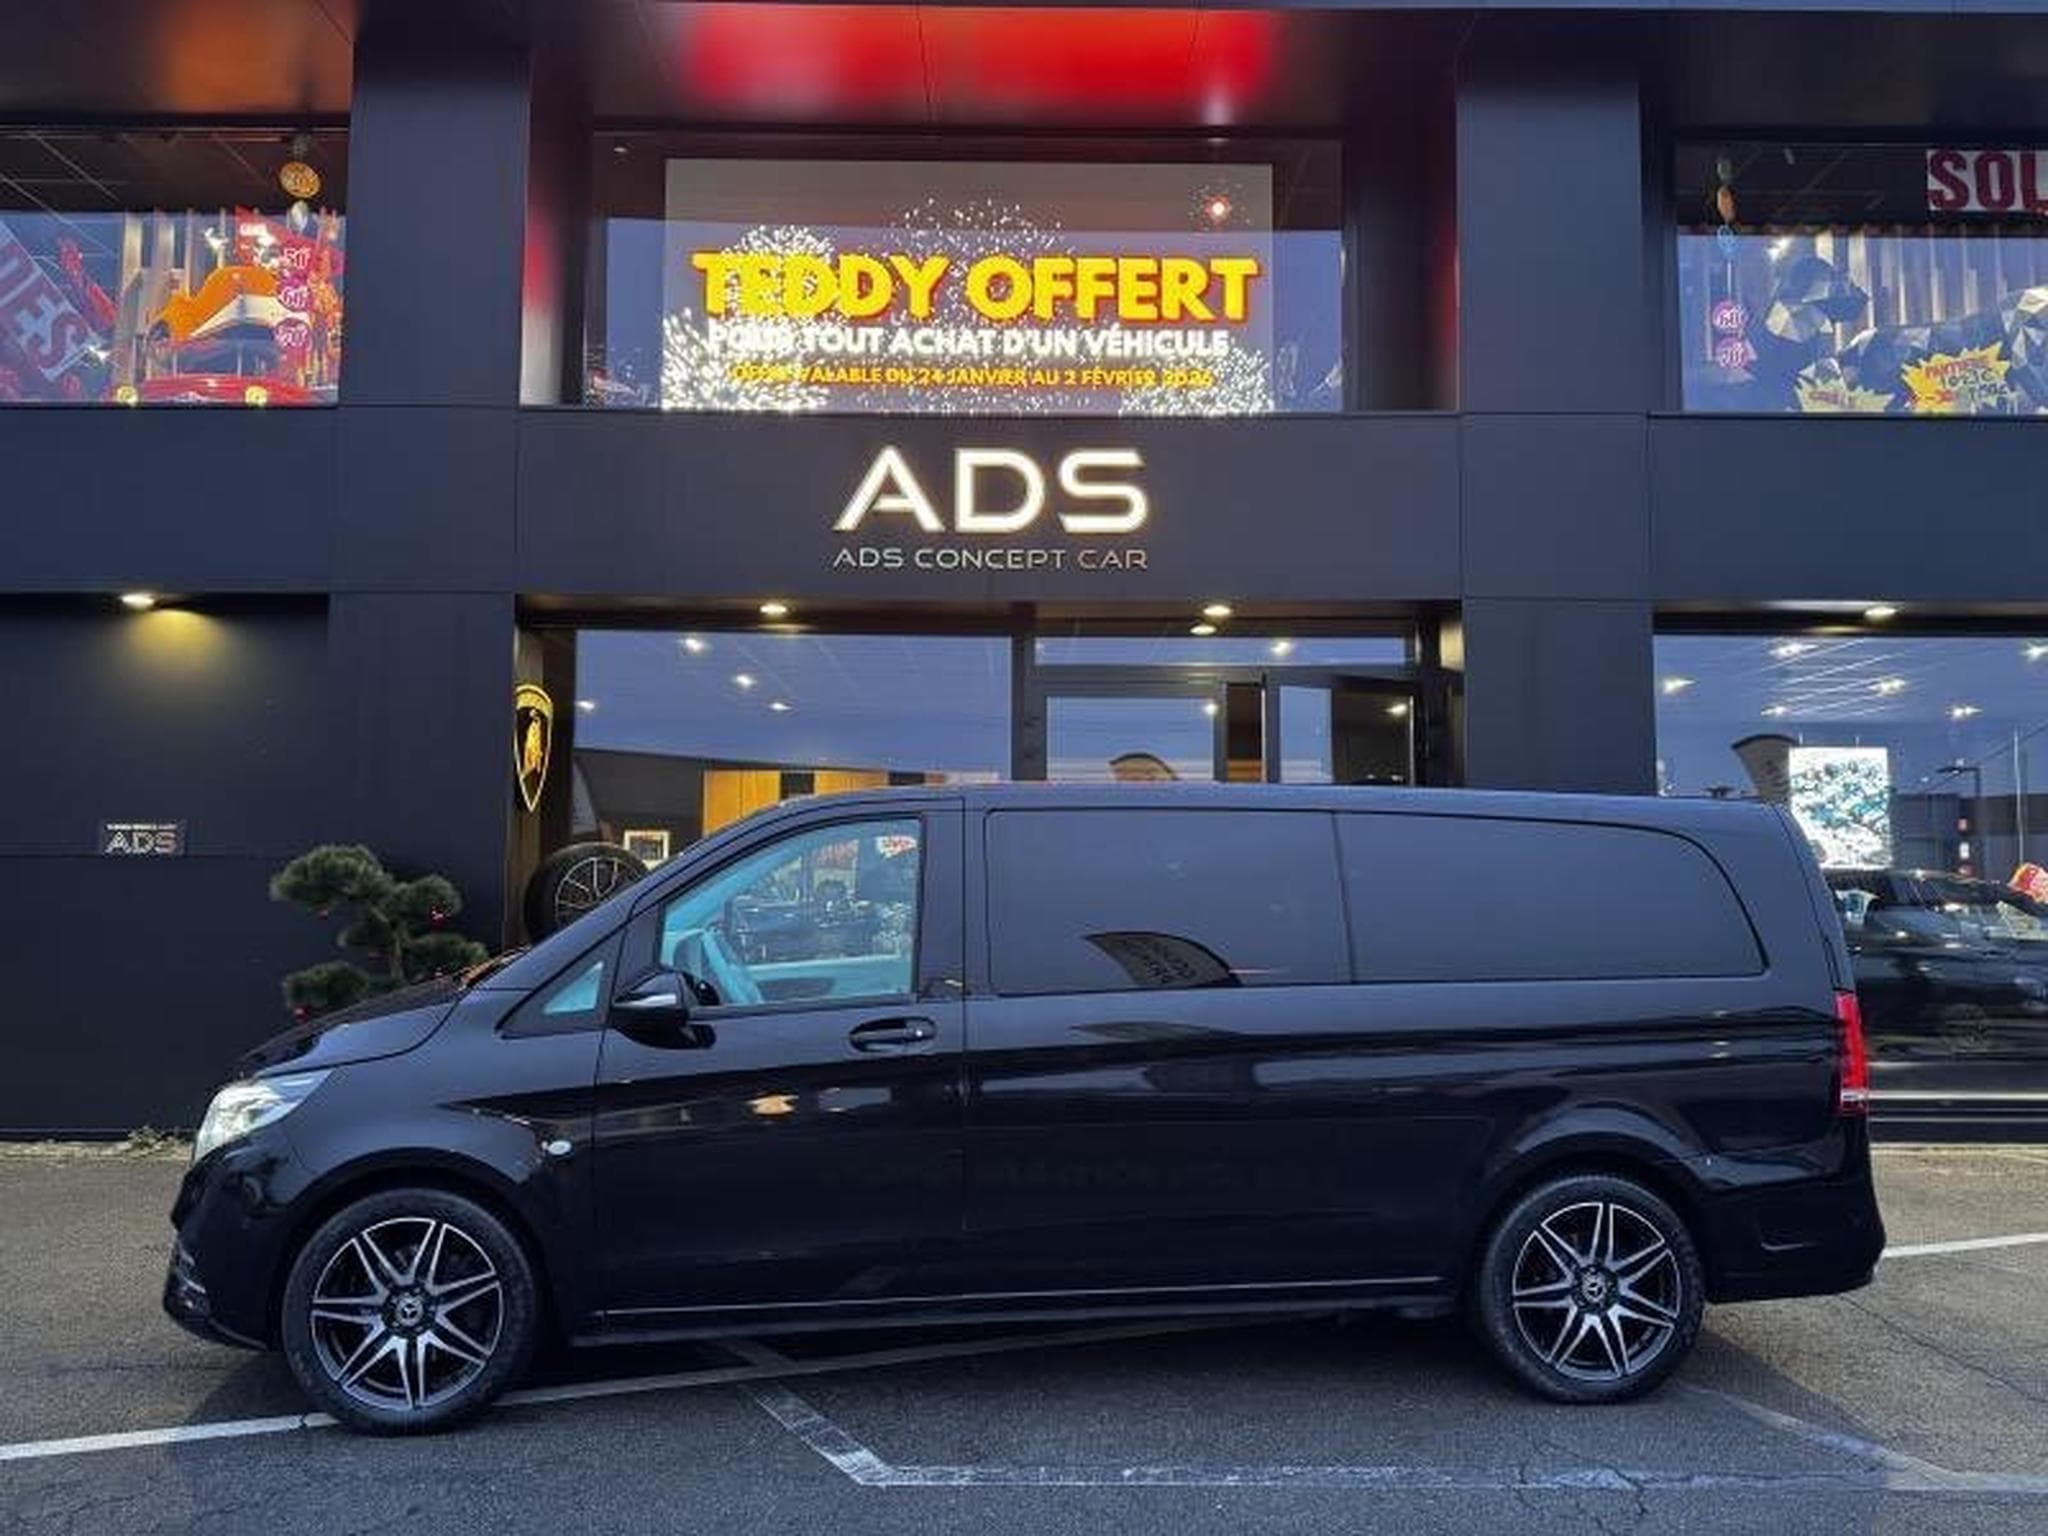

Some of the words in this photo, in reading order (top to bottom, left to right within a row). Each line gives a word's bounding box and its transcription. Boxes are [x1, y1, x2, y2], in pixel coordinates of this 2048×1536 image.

[693, 252, 951, 320] TEDDY
[966, 256, 1259, 323] OFFERT
[805, 326, 884, 353] TOUT
[888, 328, 995, 354] ACHAT
[1001, 329, 1077, 356] D'UN
[1085, 323, 1230, 357] VÉHICULE
[1033, 369, 1060, 385] AU
[1064, 370, 1077, 385] 2
[832, 446, 1149, 534] ADS
[833, 549, 904, 569] ADS
[914, 549, 1067, 569] CONCEPT
[1077, 550, 1148, 569] CAR
[105, 831, 177, 854] ADS
